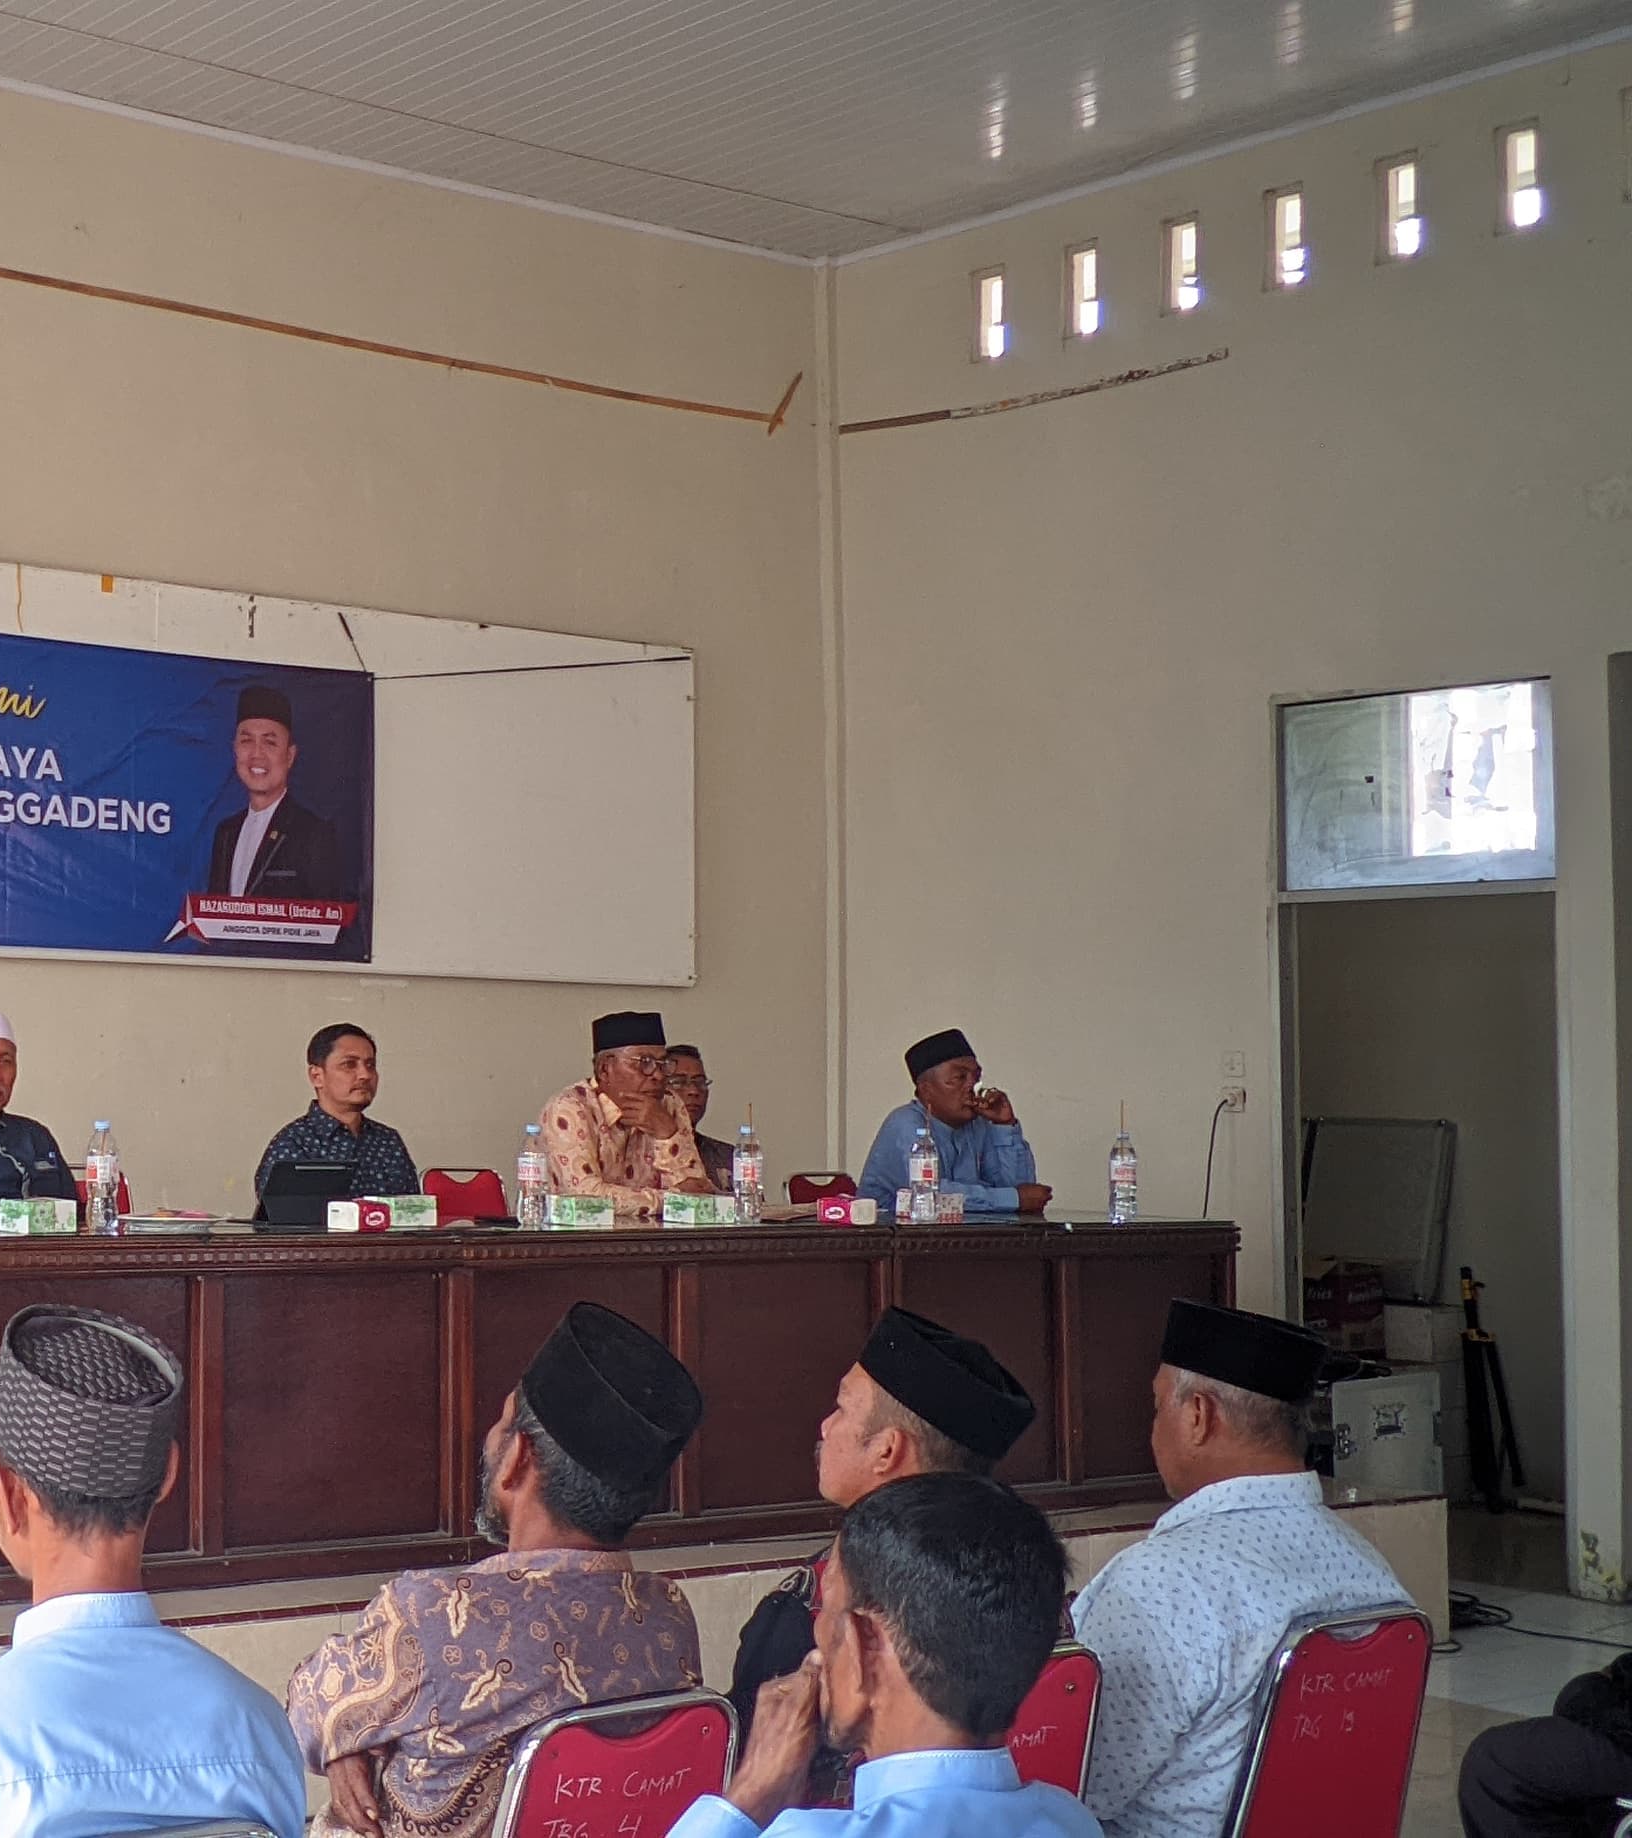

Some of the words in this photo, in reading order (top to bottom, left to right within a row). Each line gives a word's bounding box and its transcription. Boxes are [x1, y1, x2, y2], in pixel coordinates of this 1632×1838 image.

[223, 925, 260, 934] ANGGOTA
[262, 927, 280, 936] DPRK
[283, 928, 301, 936] PIDIE
[303, 929, 320, 937] JAYA
[1300, 1671, 1335, 1700] KTR
[1011, 1724, 1058, 1749] AMAT
[1292, 1711, 1322, 1742] TRG
[622, 1768, 691, 1797] CAMAT
[618, 1814, 641, 1838] 4
